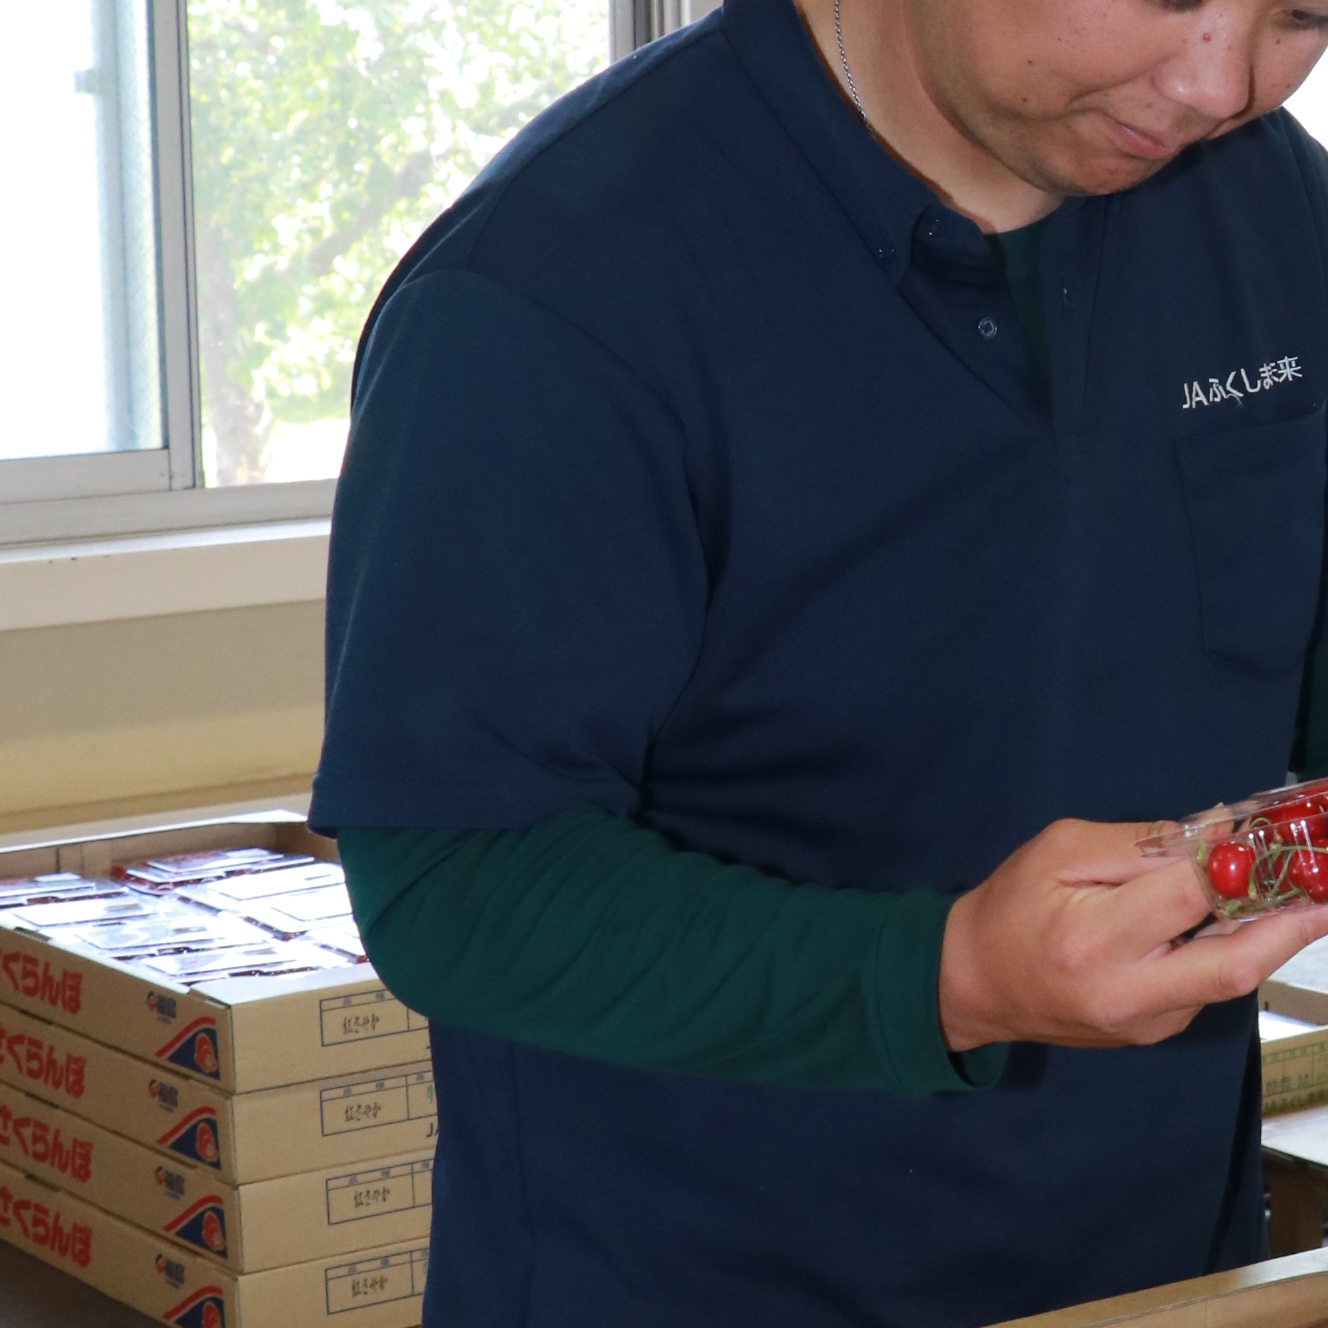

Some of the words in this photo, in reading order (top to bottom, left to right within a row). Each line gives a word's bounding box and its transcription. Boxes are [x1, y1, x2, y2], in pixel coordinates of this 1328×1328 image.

[1182, 356, 1303, 409] JAふくしま未来
[0, 949, 82, 1015] くらんぼ
